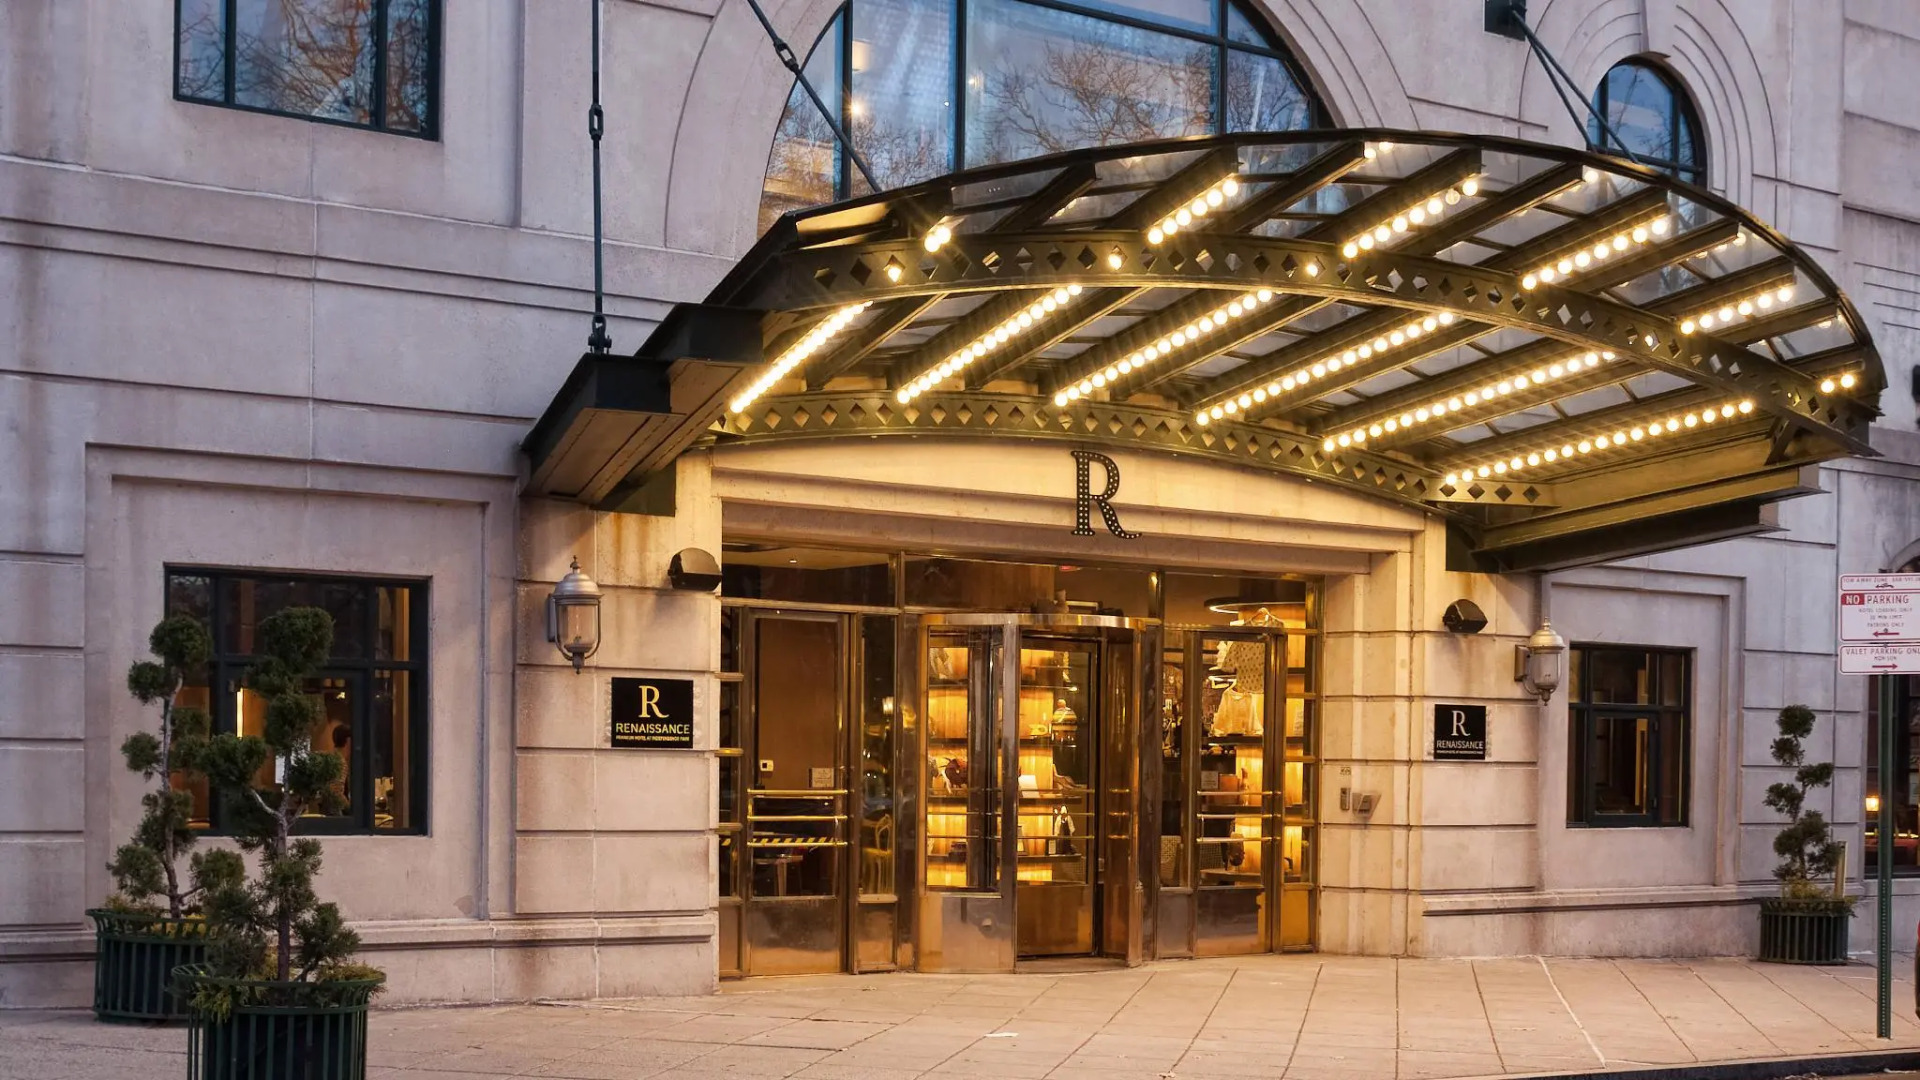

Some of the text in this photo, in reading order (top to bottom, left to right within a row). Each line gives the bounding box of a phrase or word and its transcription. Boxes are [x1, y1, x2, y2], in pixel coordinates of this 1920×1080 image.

[1070, 450, 1142, 539] R
[1845, 594, 1909, 604] NO PARKING
[1906, 647, 1920, 655] ONL
[638, 685, 670, 719] R
[615, 723, 690, 734] RENAISSANCE
[1450, 710, 1471, 736] R
[1436, 740, 1484, 749] RENAISSANCE
